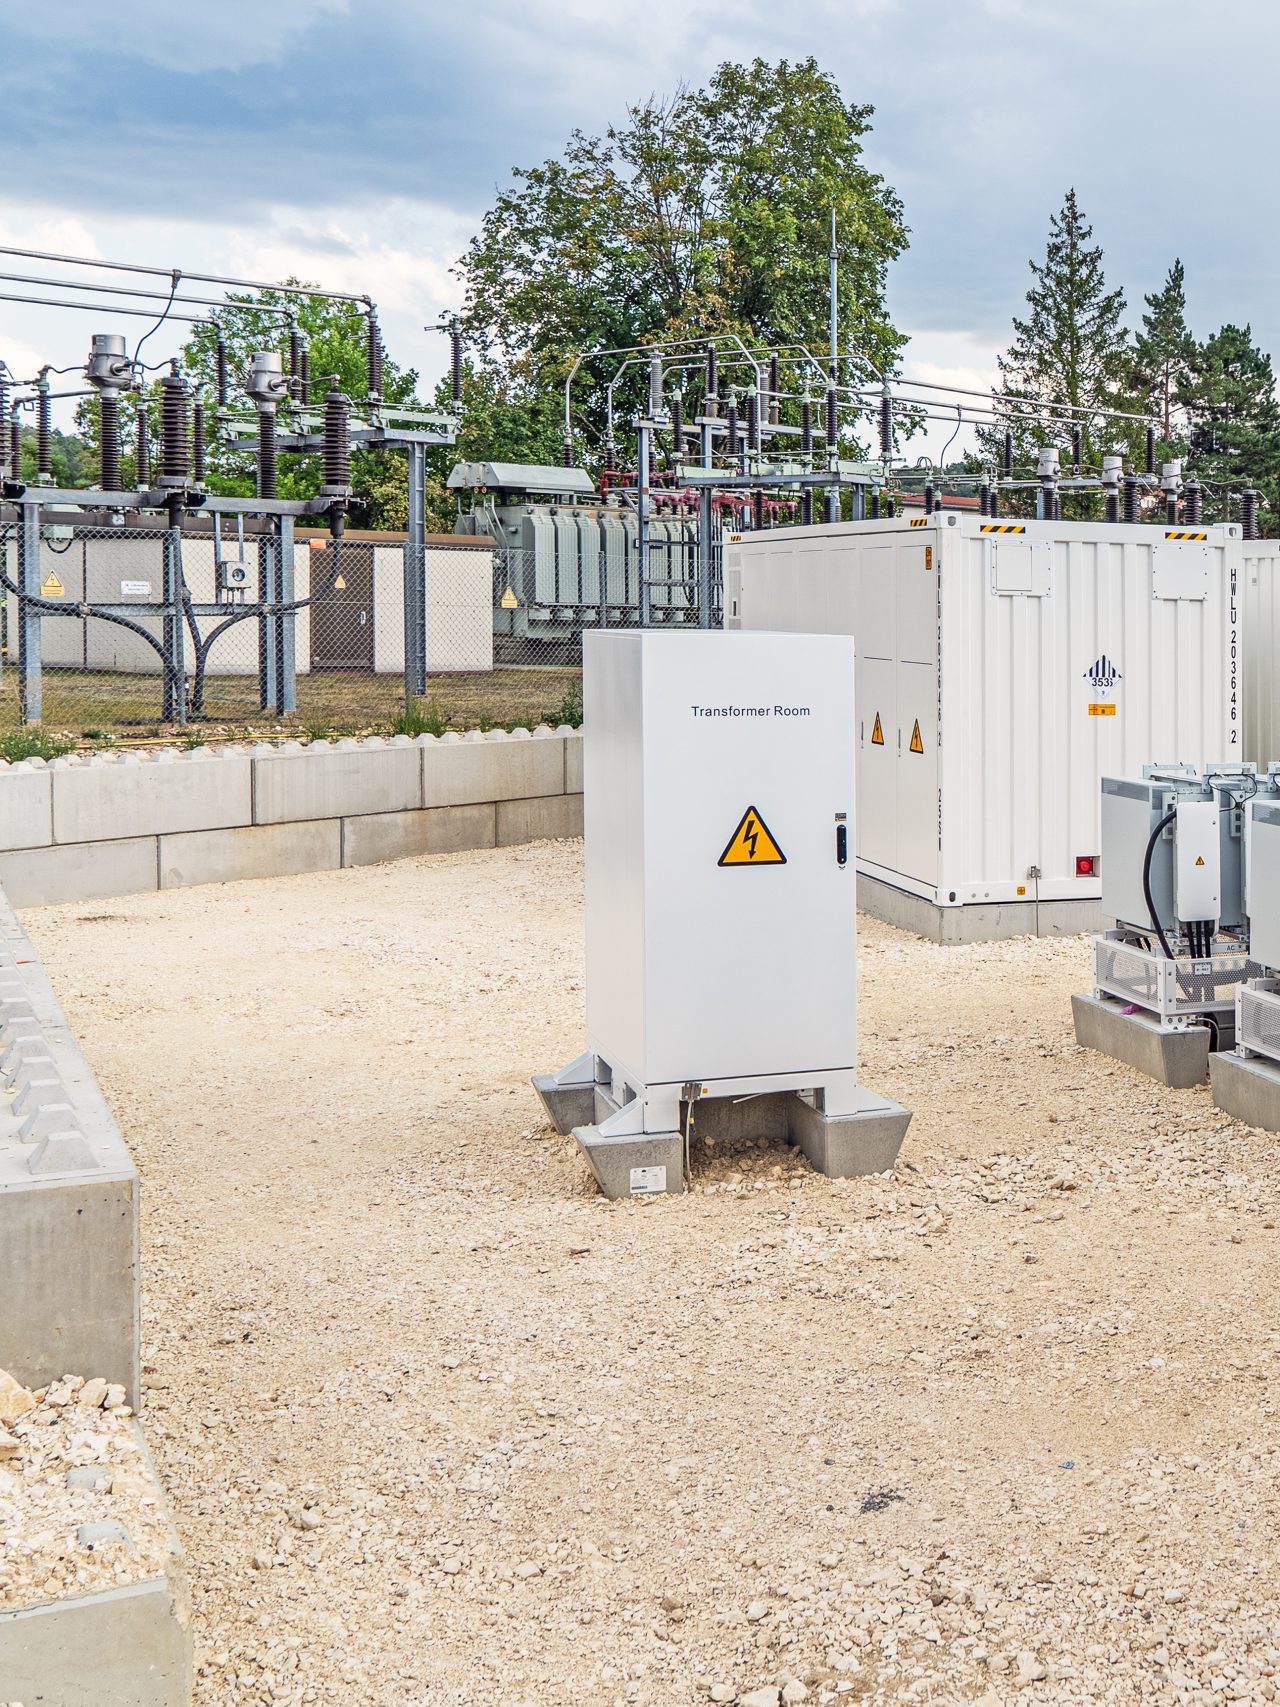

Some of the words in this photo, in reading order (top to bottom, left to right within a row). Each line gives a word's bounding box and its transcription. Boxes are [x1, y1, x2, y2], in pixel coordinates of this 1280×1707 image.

[691, 705, 771, 717] Transformer
[774, 705, 811, 717] Room
[1230, 729, 1238, 744] 2
